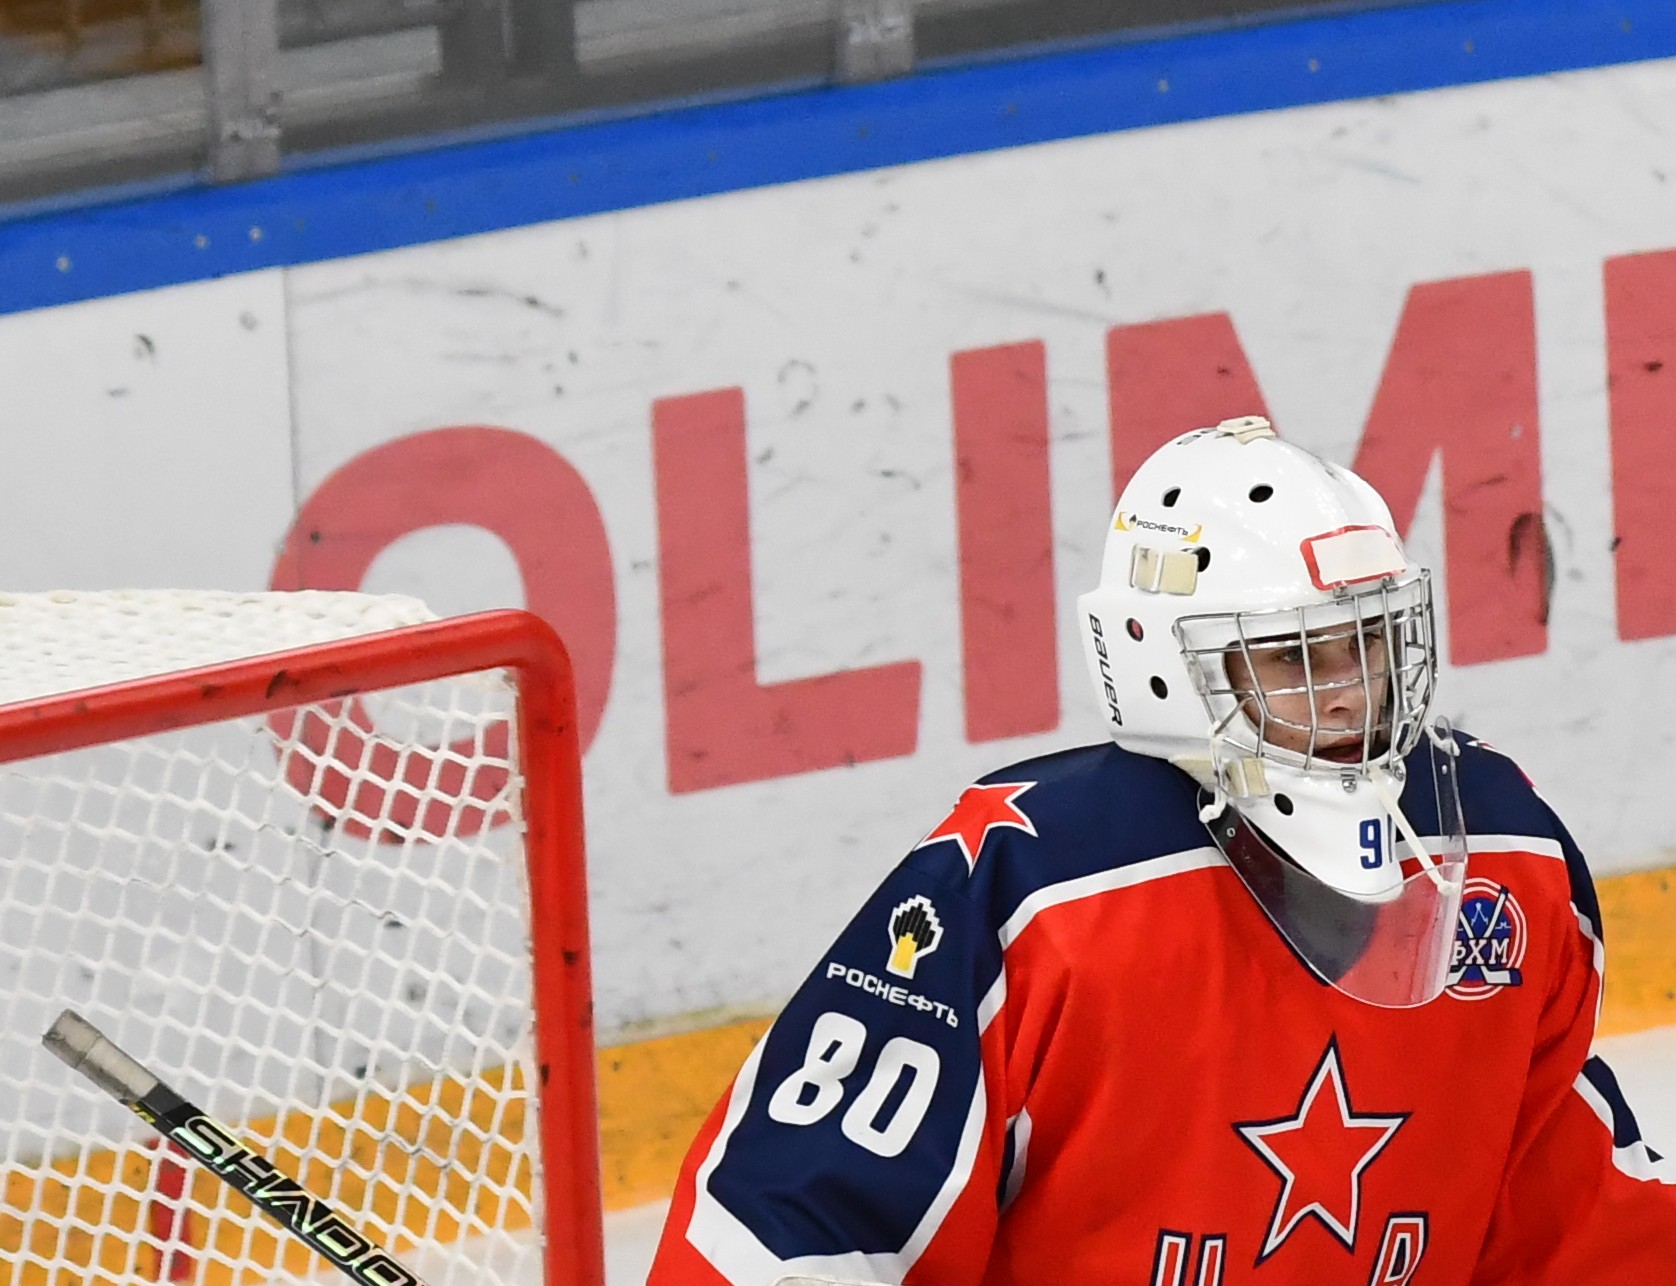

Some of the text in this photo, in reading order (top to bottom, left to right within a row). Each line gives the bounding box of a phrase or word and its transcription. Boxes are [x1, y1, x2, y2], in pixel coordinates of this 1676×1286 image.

[1136, 516, 1190, 537] РОСНЕФТЬ
[1088, 612, 1124, 728] BAUER
[826, 961, 960, 1030] РОСНЕФТЬ
[767, 1011, 941, 1158] 80
